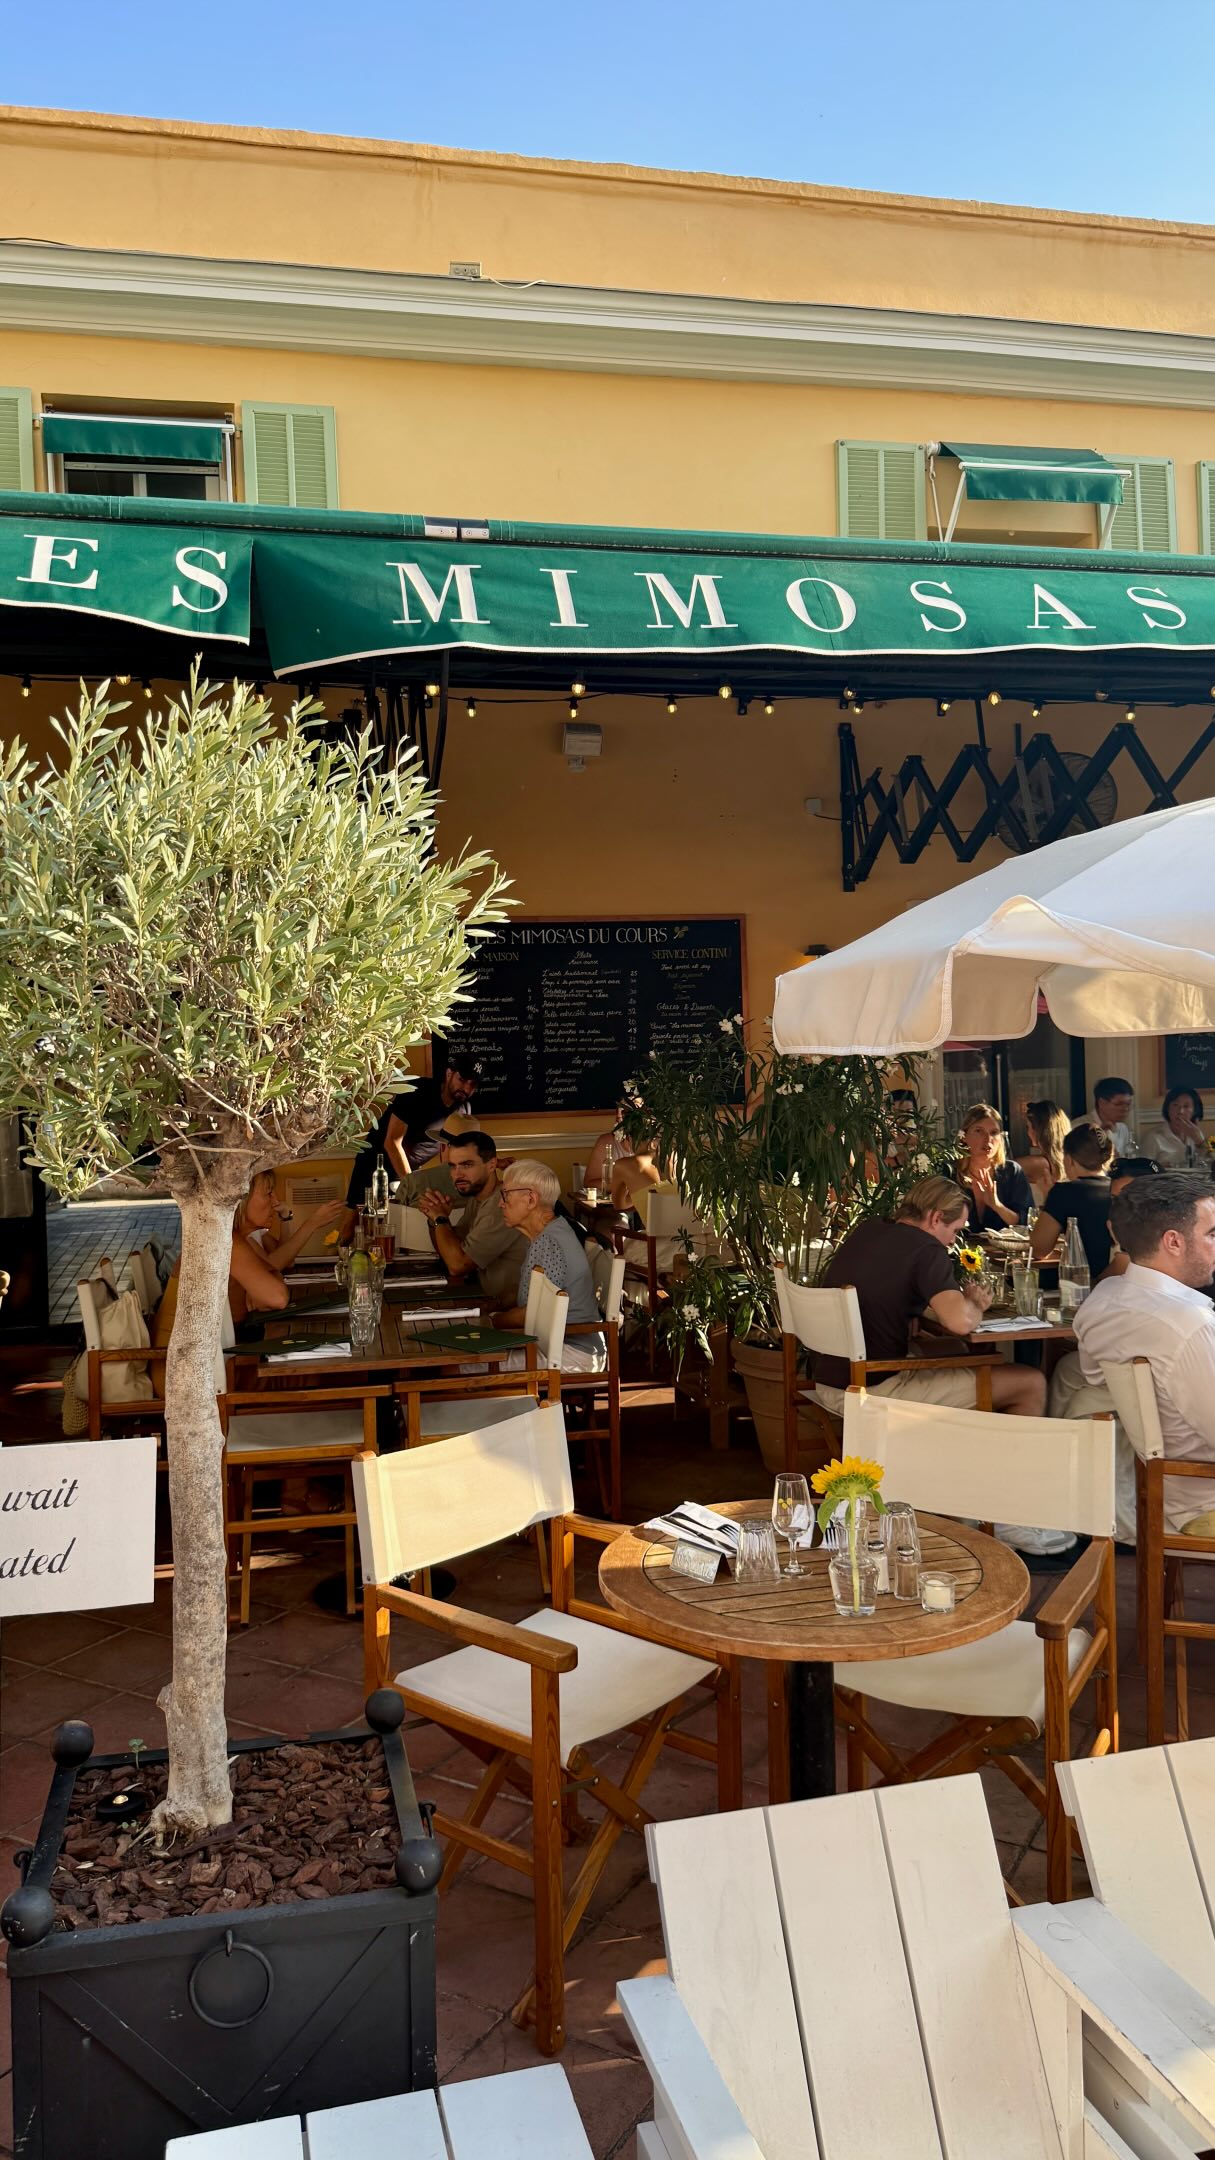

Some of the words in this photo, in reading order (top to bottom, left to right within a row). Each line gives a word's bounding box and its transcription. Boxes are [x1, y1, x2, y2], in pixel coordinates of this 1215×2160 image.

[384, 560, 1188, 634] MIMOSAS
[474, 928, 506, 945] LES
[511, 927, 585, 945] MIMOSAS
[588, 927, 610, 944] DU
[615, 926, 668, 943] COURS
[482, 951, 519, 961] MAISON
[651, 948, 688, 960] SERVICE
[691, 946, 732, 959] CONTINU
[1, 1478, 80, 1512] wait
